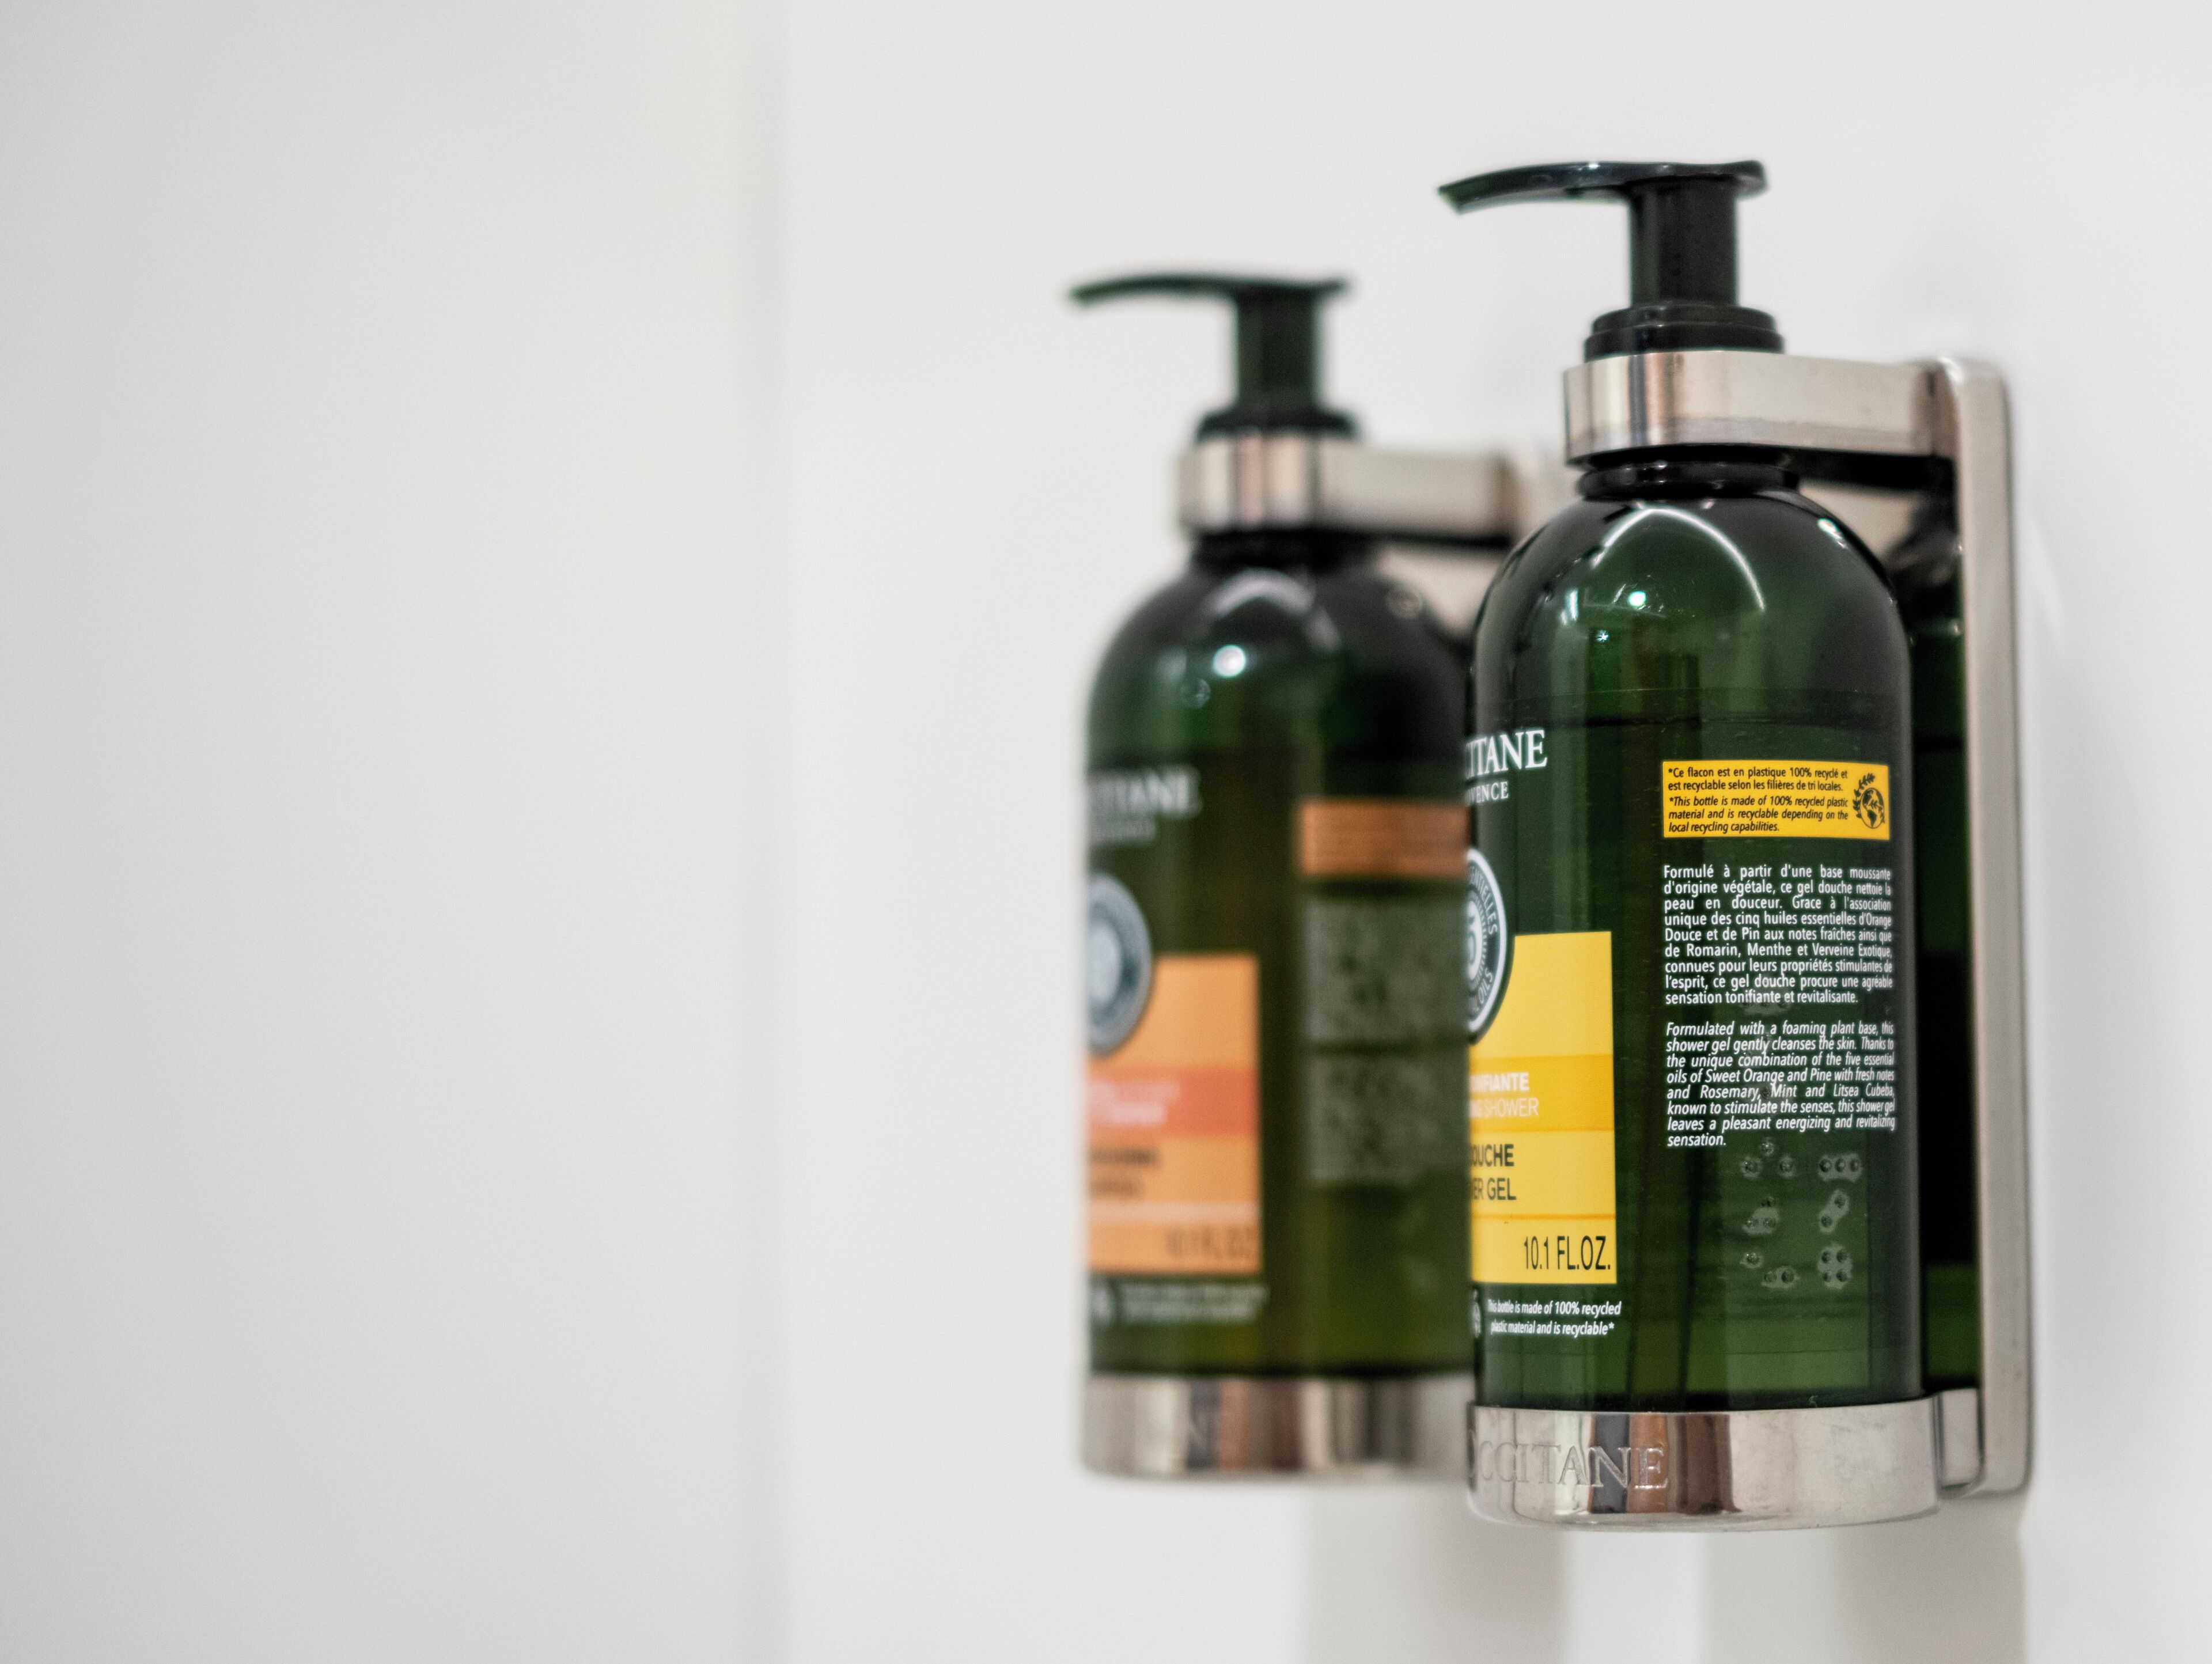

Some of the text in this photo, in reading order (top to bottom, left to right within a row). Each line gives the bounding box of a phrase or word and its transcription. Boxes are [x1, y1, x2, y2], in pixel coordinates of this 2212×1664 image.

[1687, 767, 1714, 777] flacon
[1717, 768, 1730, 777] est
[1748, 767, 1786, 780] plastique
[1791, 768, 1812, 778] 100%
[1815, 767, 1838, 780] recyclé
[1840, 769, 1847, 778] et
[1668, 779, 1843, 793] est recyclable selon les filières de tri locales.
[1692, 795, 1848, 809] bottle is made of 100% recycled plastic
[1668, 808, 1849, 822] material and is recyclable depending on the
[1668, 821, 1779, 835] local recycling capabilities.
[1664, 864, 1891, 882] Formulé partir d'une base moussante
[1664, 879, 1883, 897] d'origine végétale, ce gel douche nettoie
[1664, 899, 1694, 913] peau
[1705, 899, 1720, 909] en
[1731, 894, 1782, 909] douceur.
[1664, 911, 1856, 929] unique des cinq huiles essentielles
[1665, 926, 1892, 945] Douce et de Pin aux notes fraîches ainsi que
[1664, 943, 1680, 957] de
[1686, 943, 1741, 960] Romarin,
[1747, 942, 1791, 956] Menthe
[1797, 944, 1808, 956] et
[1812, 943, 1854, 957] Verveine
[1665, 958, 1892, 976] connues pour leurs propriétés stimulantes de
[1713, 973, 1892, 992] ce gel douche procure une agréable
[1665, 988, 1858, 1005] sensation tonifiante et revitalisante.
[1666, 1019, 1894, 1038] Formulated with foaming plant base, this
[1666, 1035, 1895, 1055] shower gel gently cleanses the skin. Thanks to
[1666, 1050, 1896, 1071] the unique combination of the five essential
[1666, 1066, 1895, 1086] oils of Sweet Orange and Pine with fresh notes
[1666, 1084, 1691, 1099] and
[1700, 1084, 1761, 1102] Rosemary,
[1770, 1083, 1798, 1097] Mint
[1805, 1082, 1827, 1097] and
[1833, 1083, 1859, 1097] Litsea
[1484, 1097, 1540, 1118] SHOWER
[1667, 1097, 1896, 1116] known to stimulate the senses, this shower gel
[1667, 1112, 1896, 1134] leaves pleasant energizing and revitalizing
[1667, 1132, 1726, 1147] sensation.
[1471, 1143, 1514, 1168] OUCHE
[1487, 1177, 1517, 1201] GEL
[1524, 1235, 1550, 1270] 10.1
[1521, 1299, 1622, 1318] made of 100% recycled
[1536, 1320, 1560, 1335] and is
[1479, 1440, 1669, 1489] CCITANE
